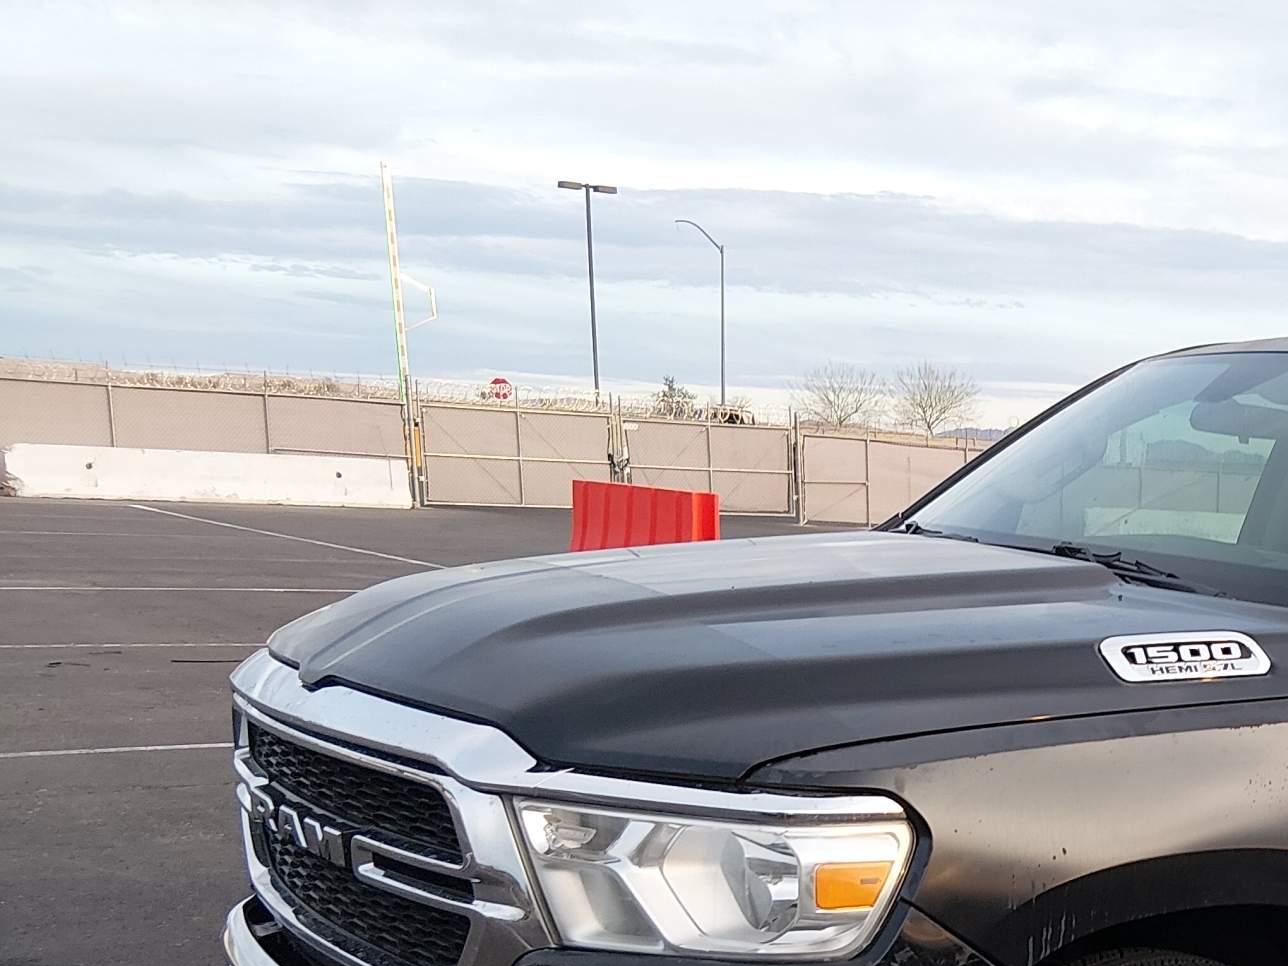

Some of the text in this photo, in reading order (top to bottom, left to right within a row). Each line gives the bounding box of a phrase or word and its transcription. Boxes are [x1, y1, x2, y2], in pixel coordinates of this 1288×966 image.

[1126, 641, 1242, 665] 1500
[1150, 664, 1199, 676] HEMI
[250, 786, 346, 868] RAM
